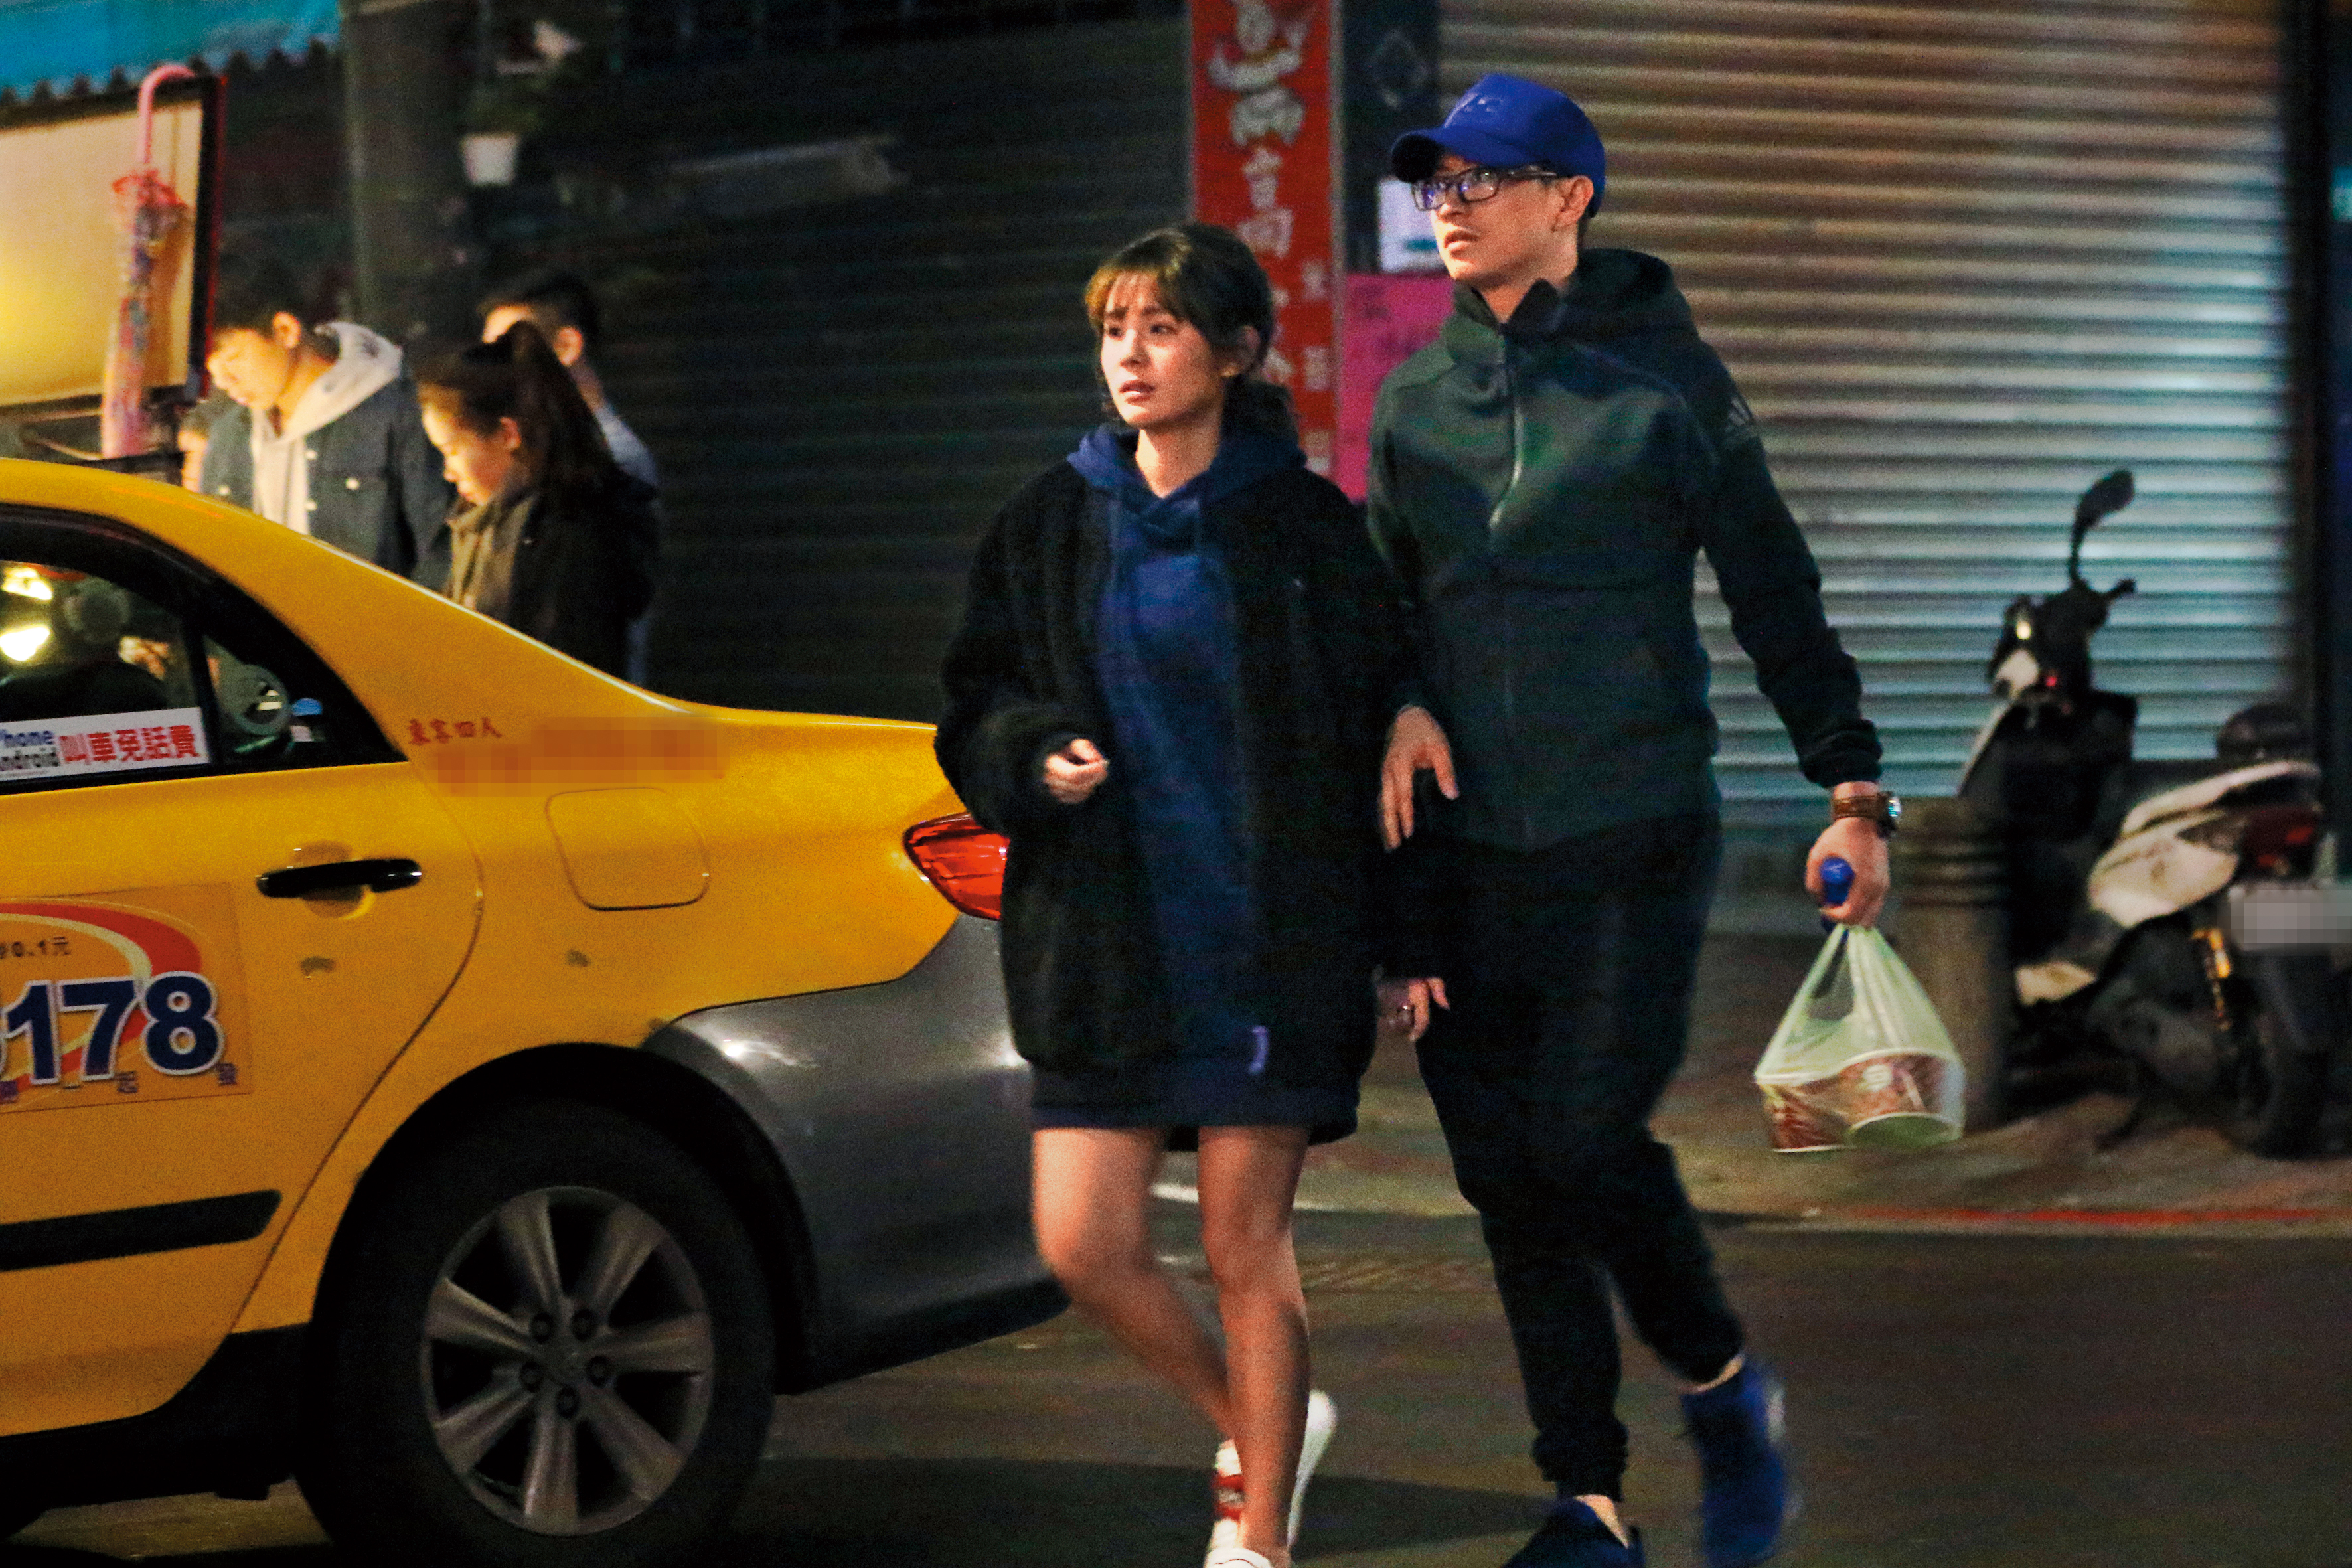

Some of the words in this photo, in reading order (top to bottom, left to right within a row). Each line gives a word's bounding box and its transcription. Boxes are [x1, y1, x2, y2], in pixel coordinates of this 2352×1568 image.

[60, 725, 199, 765] 叫車免話費
[0, 971, 224, 1085] 178
